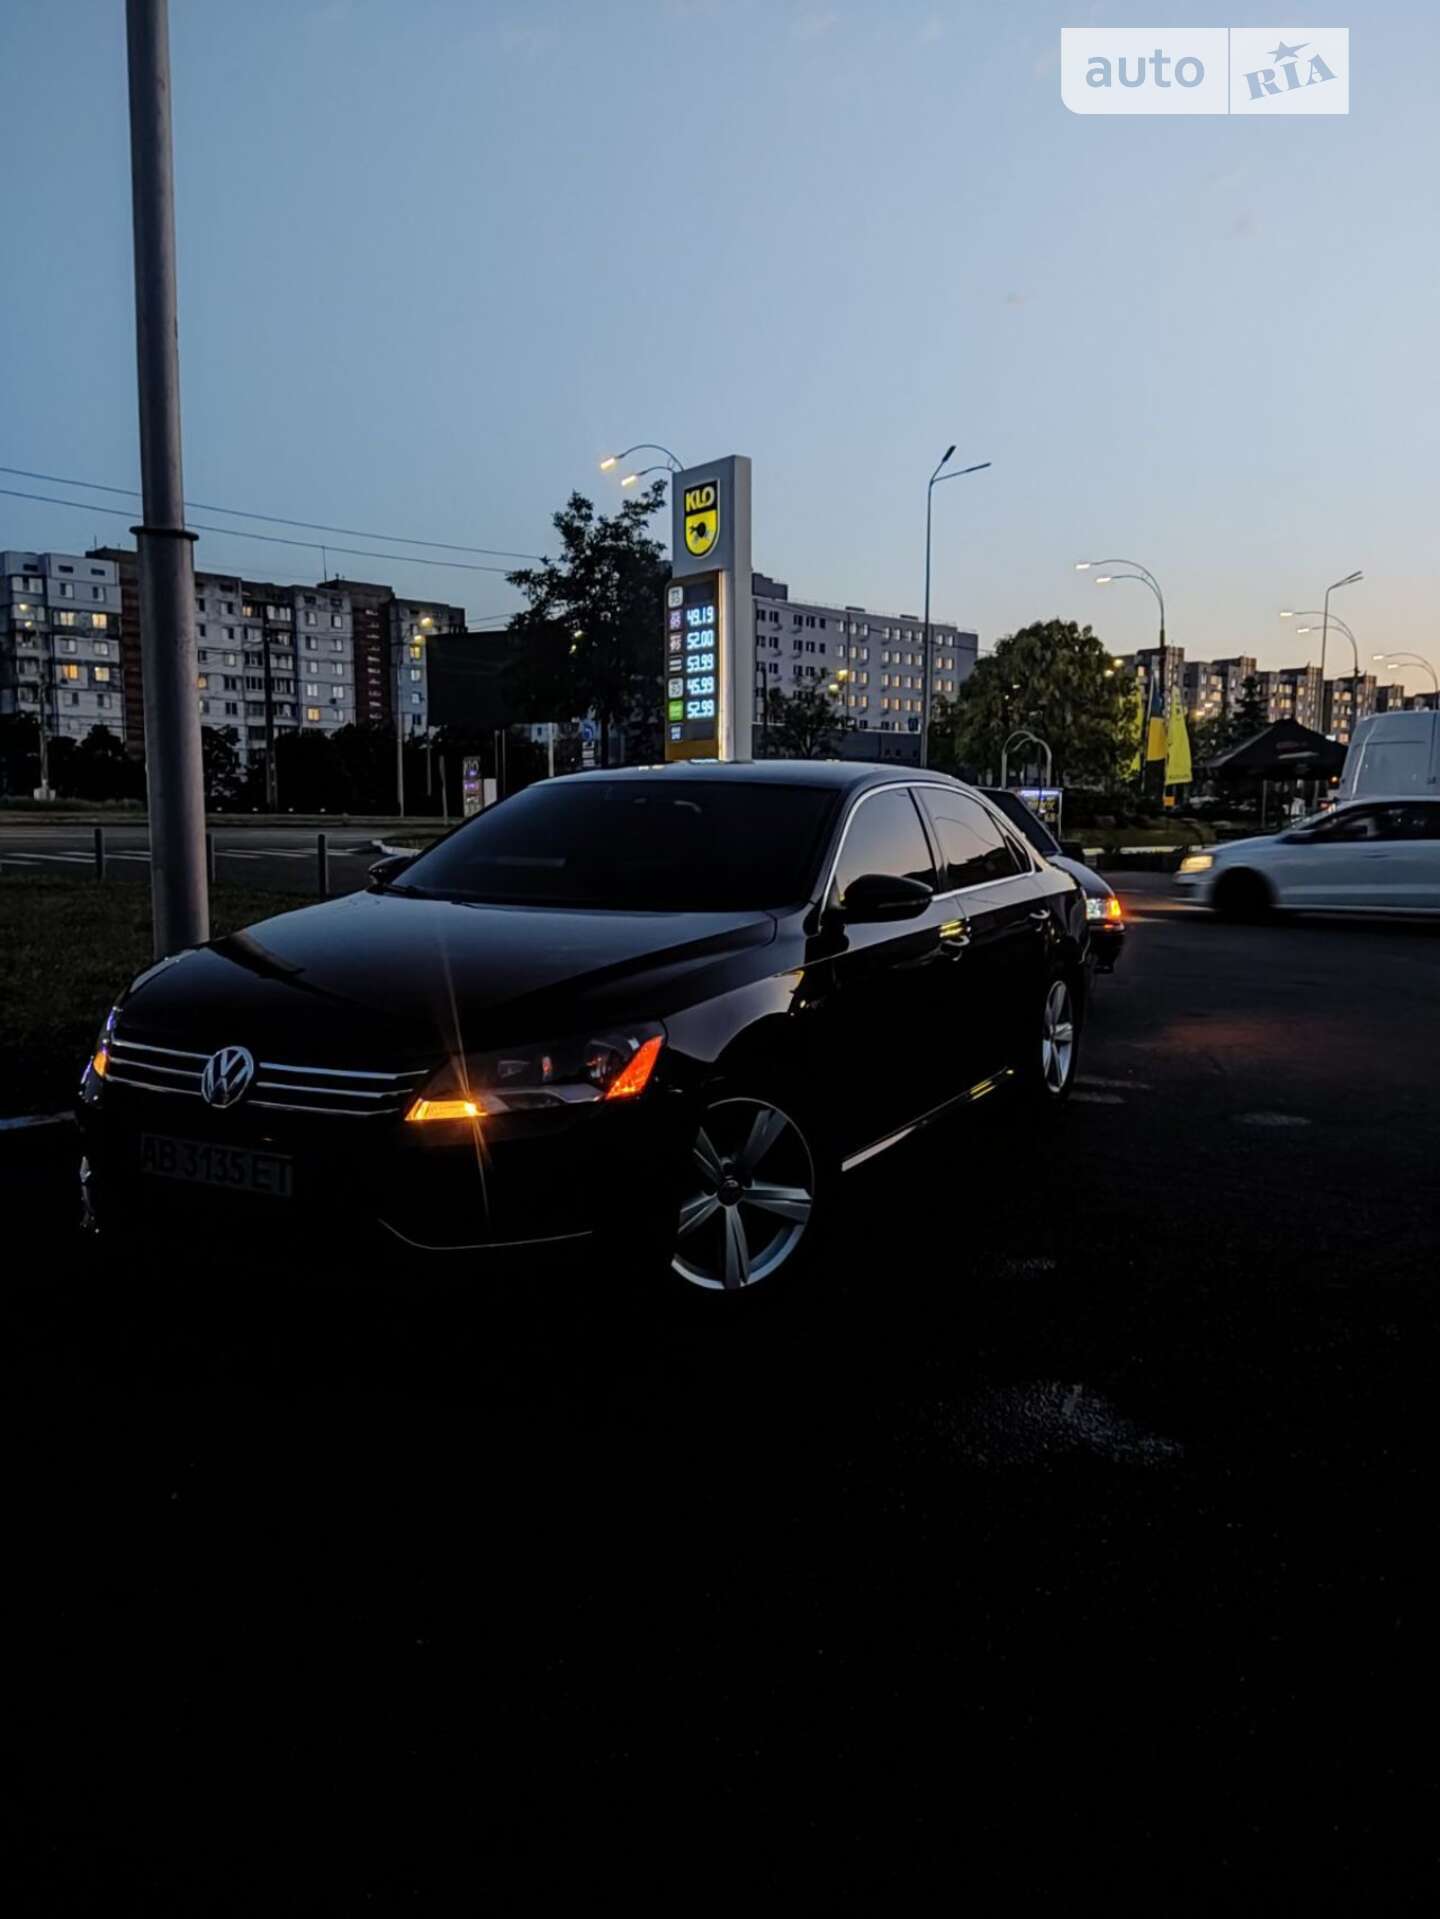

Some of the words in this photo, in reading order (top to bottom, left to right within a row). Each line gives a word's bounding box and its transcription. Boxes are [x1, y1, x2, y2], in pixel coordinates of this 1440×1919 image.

[686, 486, 715, 512] KLO
[687, 630, 714, 650] 52.00
[687, 699, 714, 719] 52.99
[180, 1142, 245, 1185] 3135
